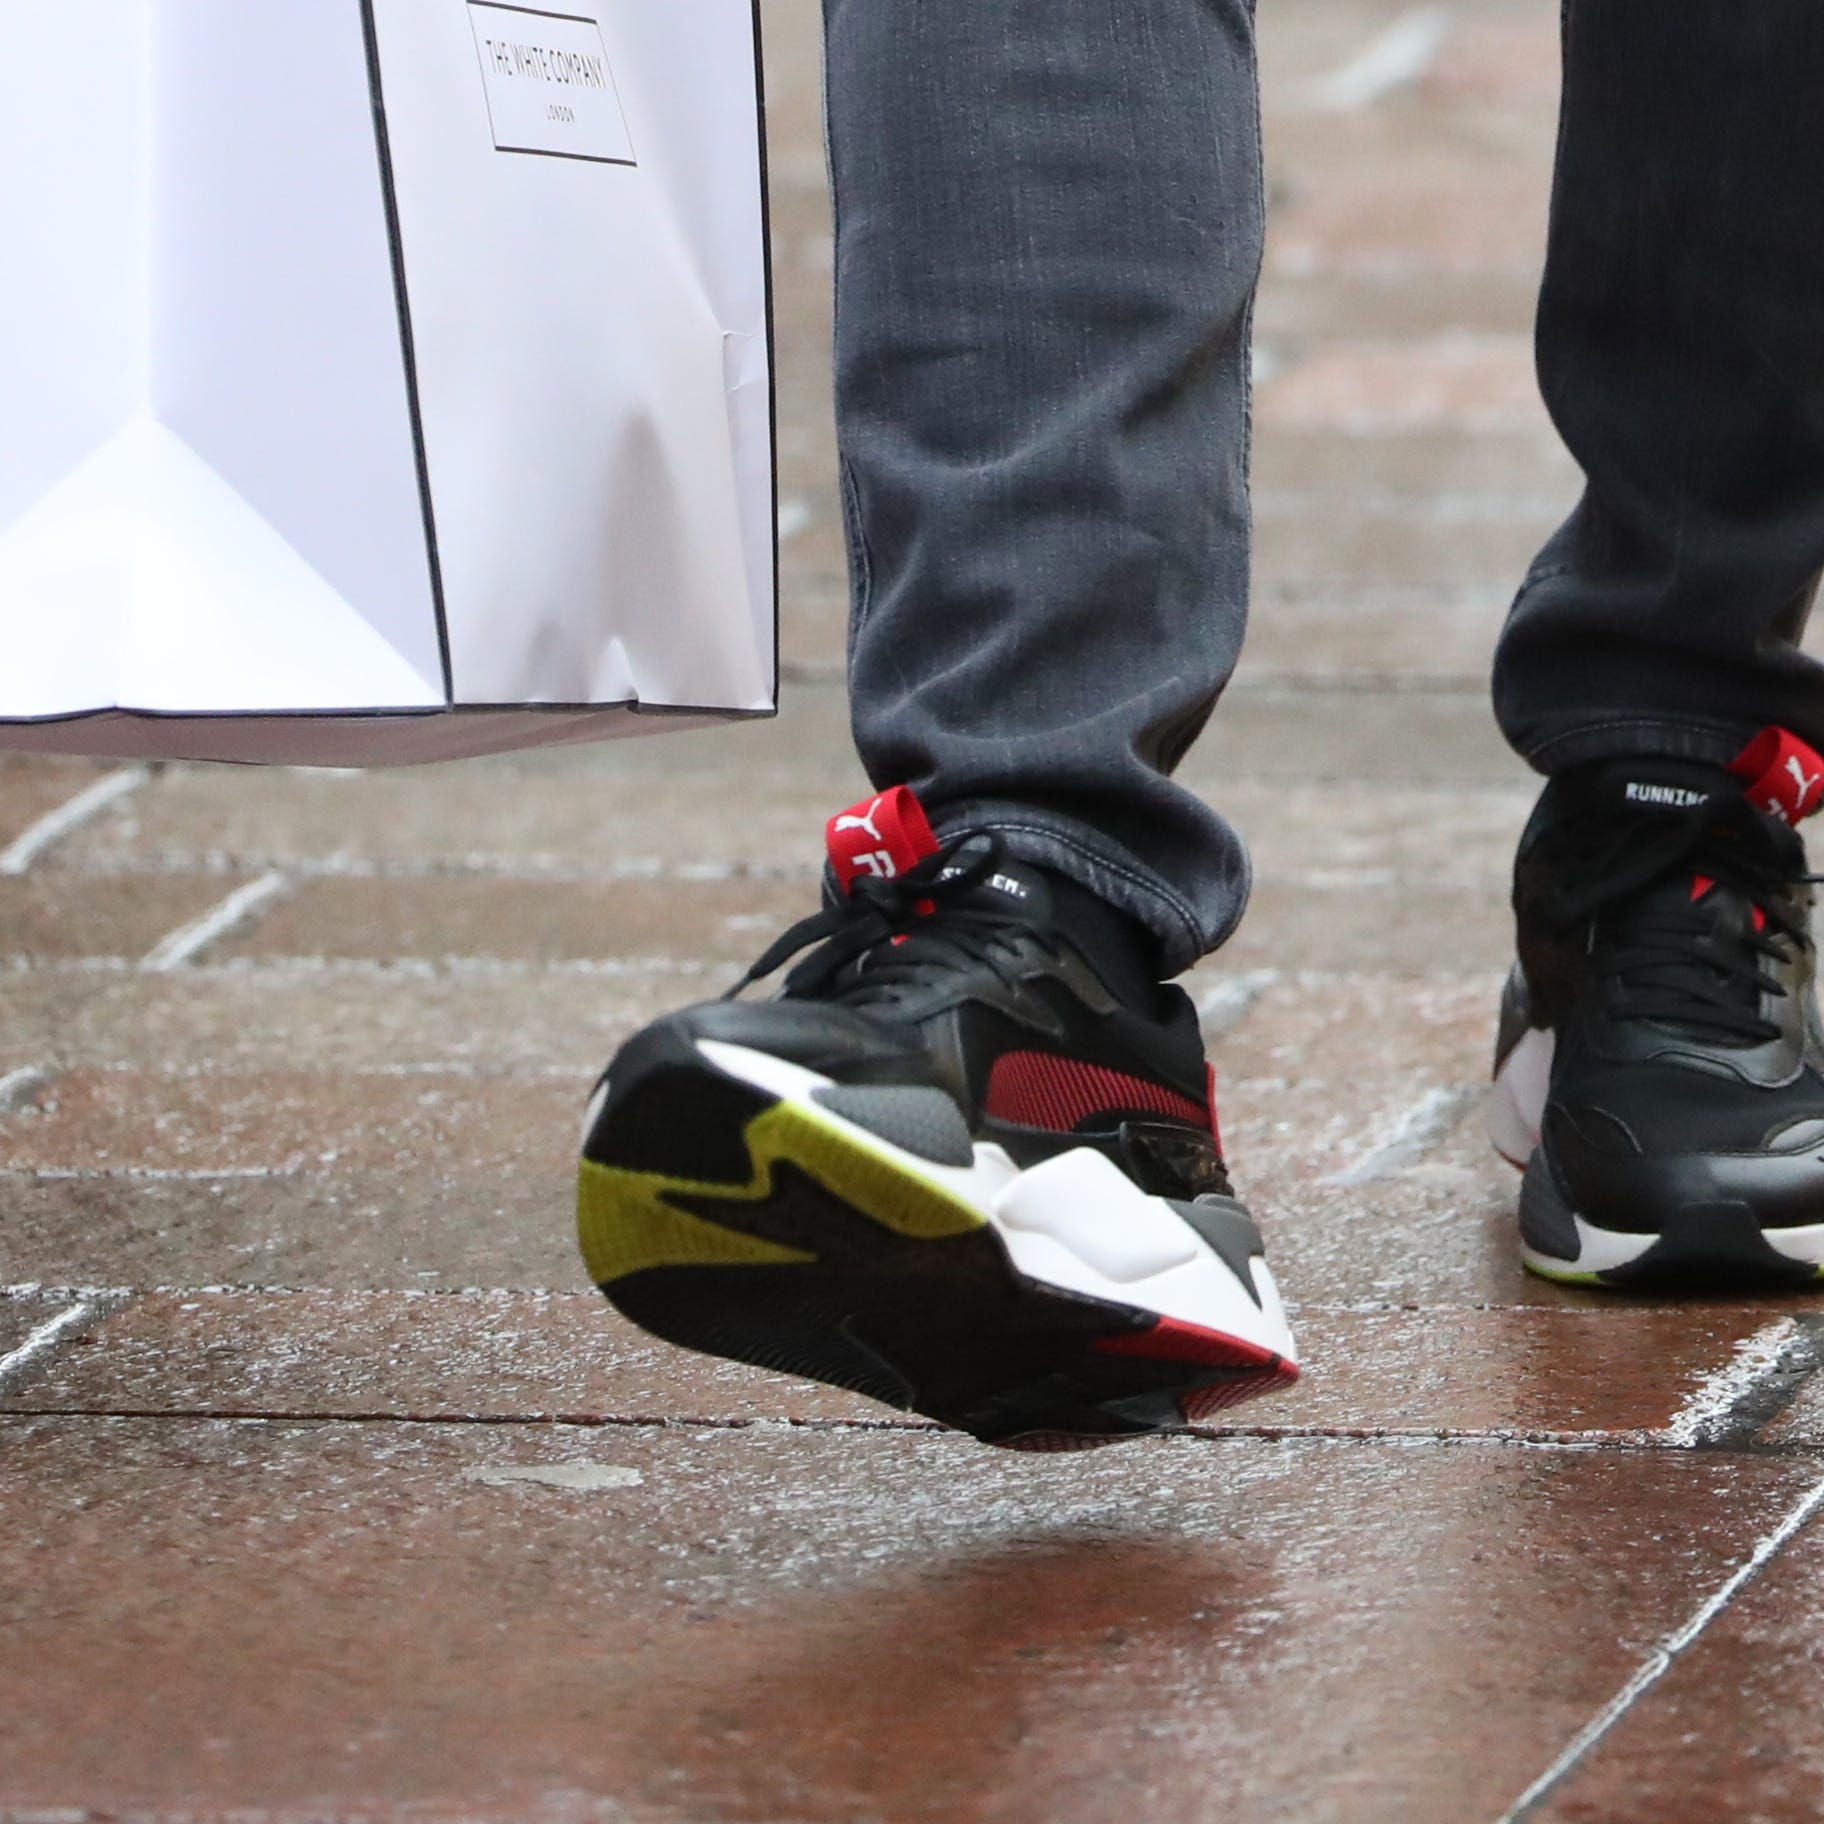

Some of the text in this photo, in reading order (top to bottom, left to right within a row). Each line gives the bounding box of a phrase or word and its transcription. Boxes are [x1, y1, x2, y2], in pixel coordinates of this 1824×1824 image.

[485, 39, 606, 89] THE WHITE COMPANY
[544, 103, 575, 123] LONDON
